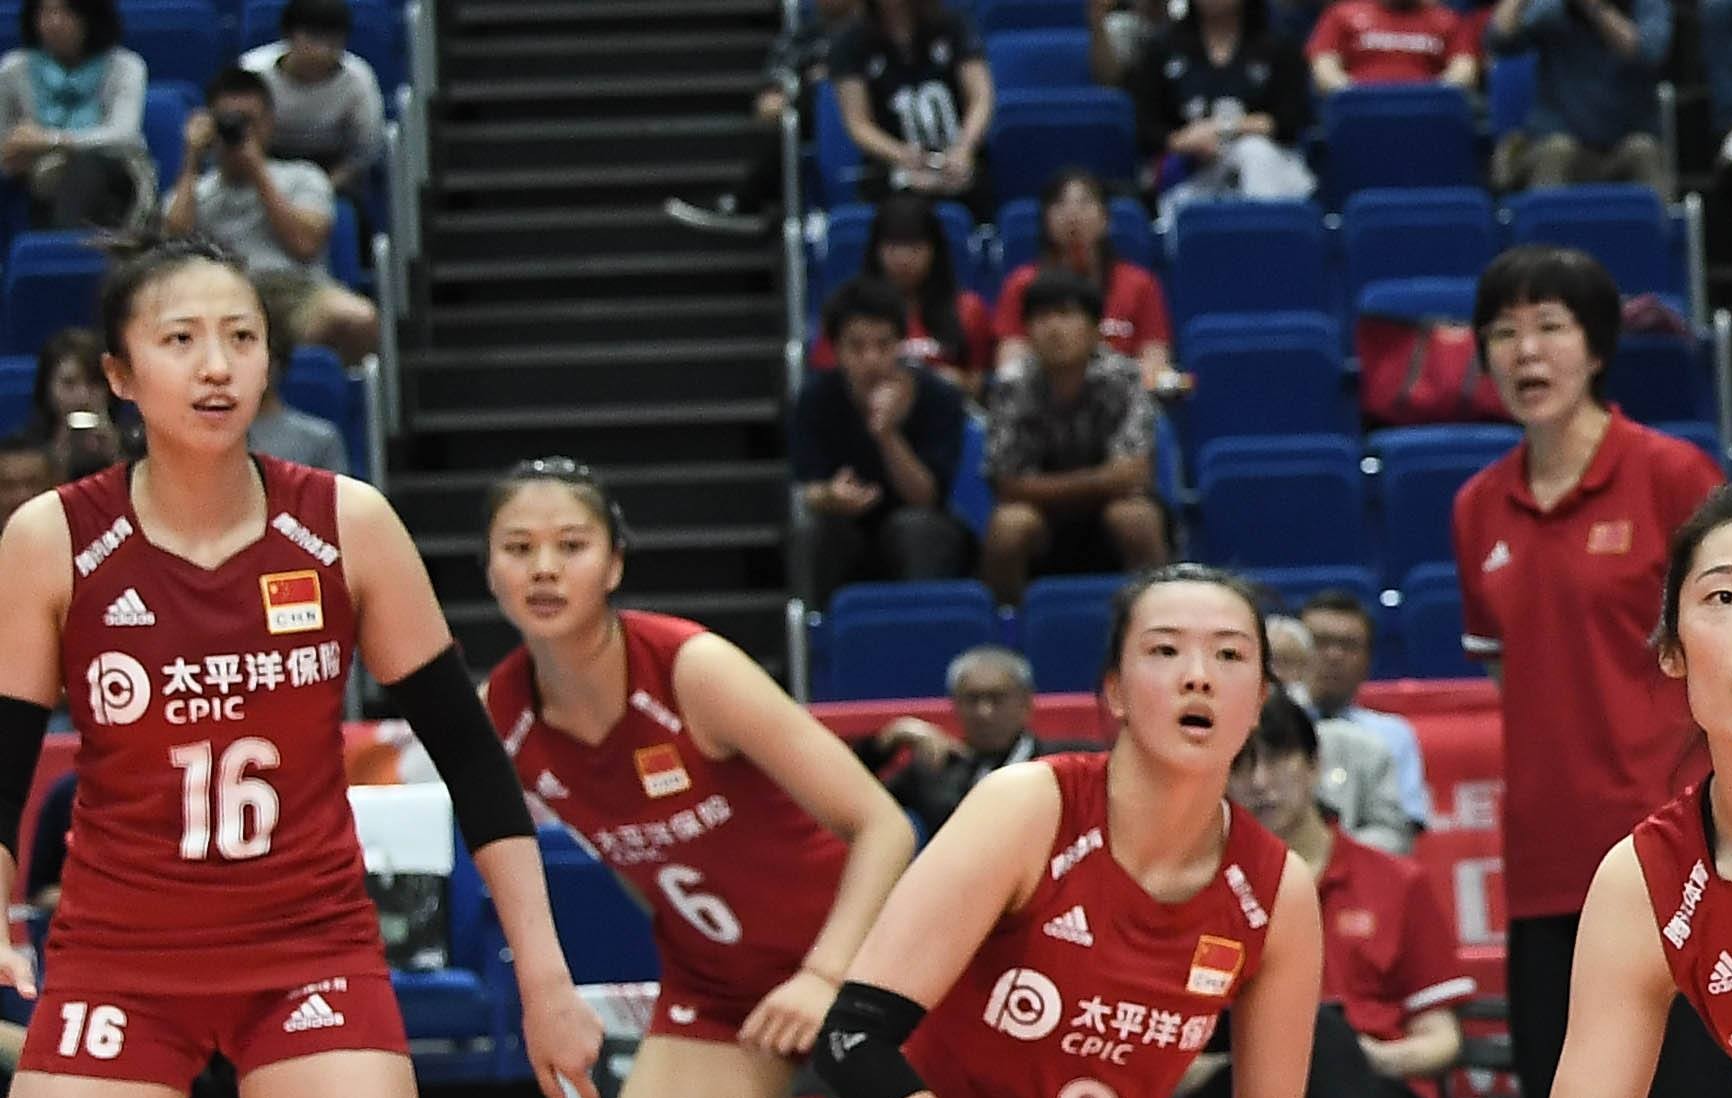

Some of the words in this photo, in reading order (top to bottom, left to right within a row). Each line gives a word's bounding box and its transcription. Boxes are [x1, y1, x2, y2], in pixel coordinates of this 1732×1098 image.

[164, 695, 245, 725] CPIC
[170, 736, 281, 861] 16
[658, 864, 743, 944] 6
[59, 1001, 128, 1060] 16
[1061, 1032, 1135, 1066] CPIC
